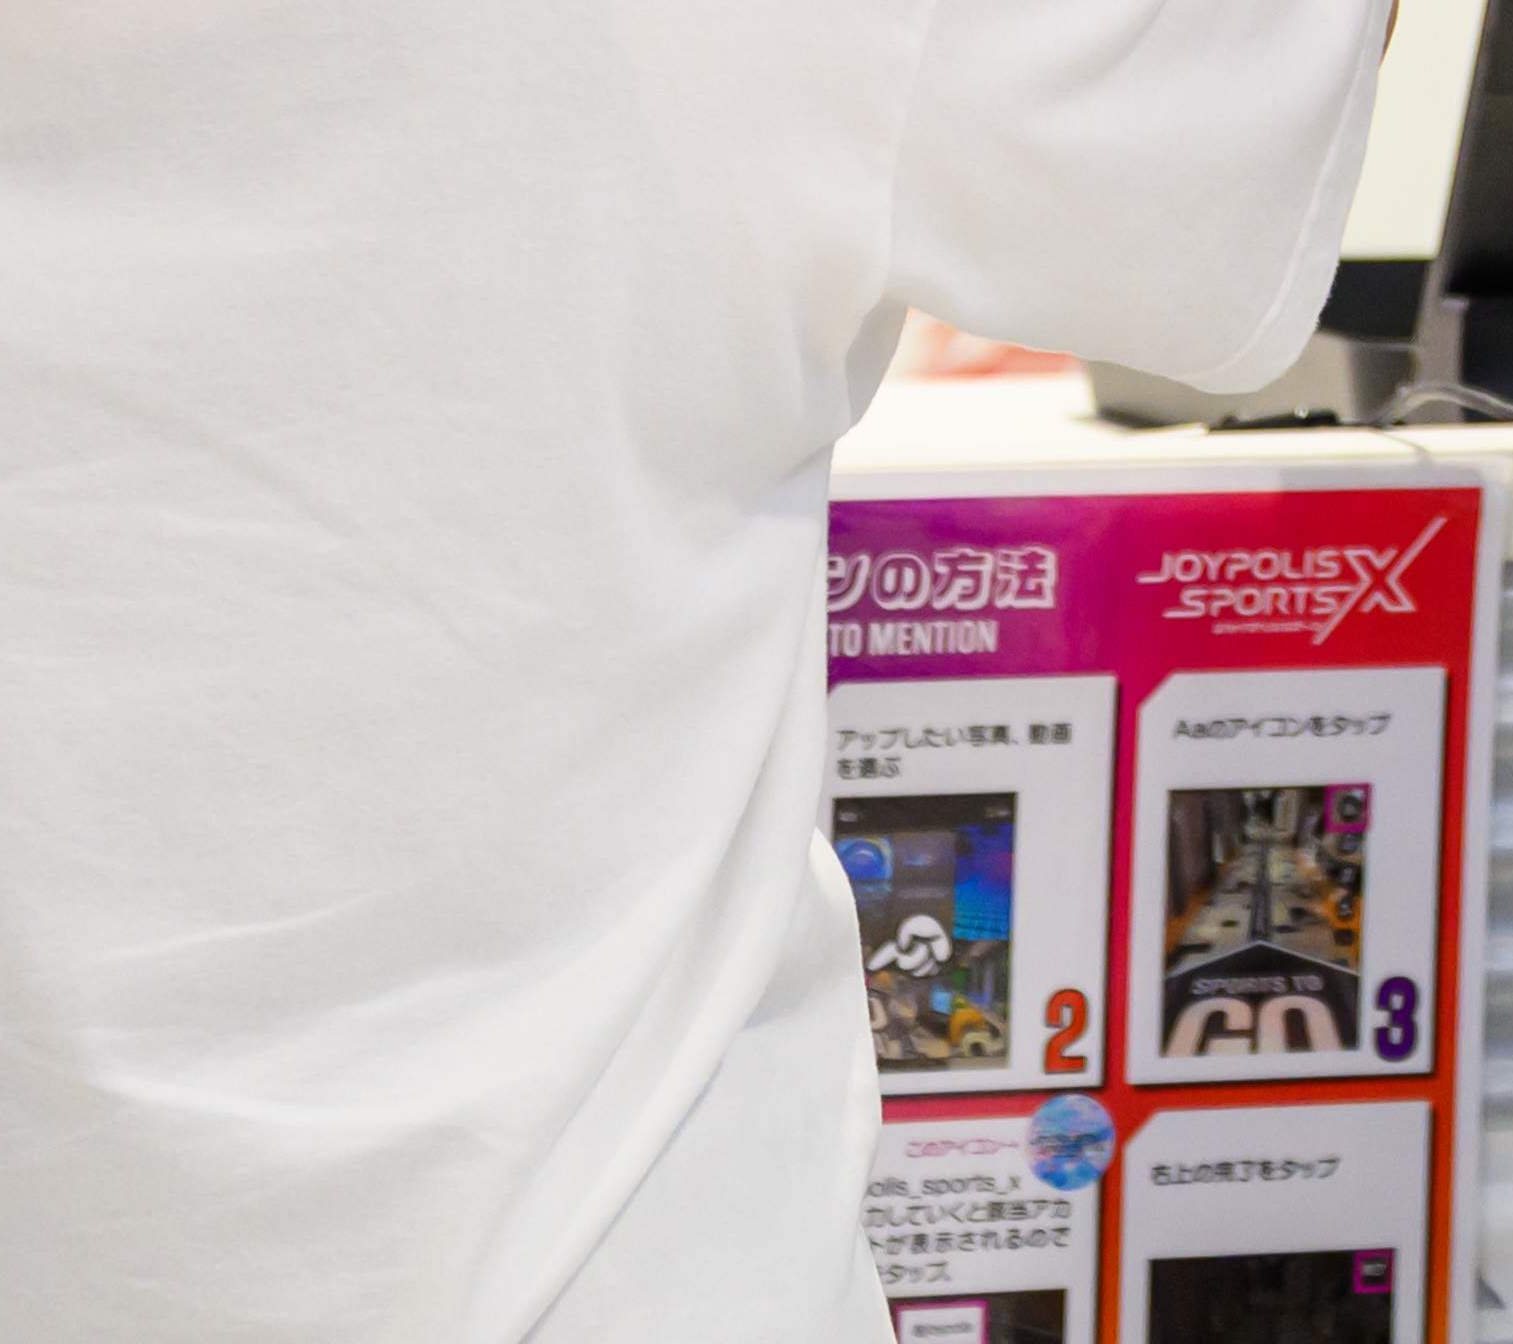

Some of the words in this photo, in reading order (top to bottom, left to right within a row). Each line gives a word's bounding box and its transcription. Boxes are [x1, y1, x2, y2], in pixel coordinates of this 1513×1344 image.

[1138, 547, 1342, 583] JOYPOLIS
[1163, 585, 1356, 619] SPORTS
[829, 622, 862, 657] TO
[868, 620, 999, 655] MENTION
[1044, 989, 1087, 1074] 2
[1376, 976, 1418, 1061] 3
